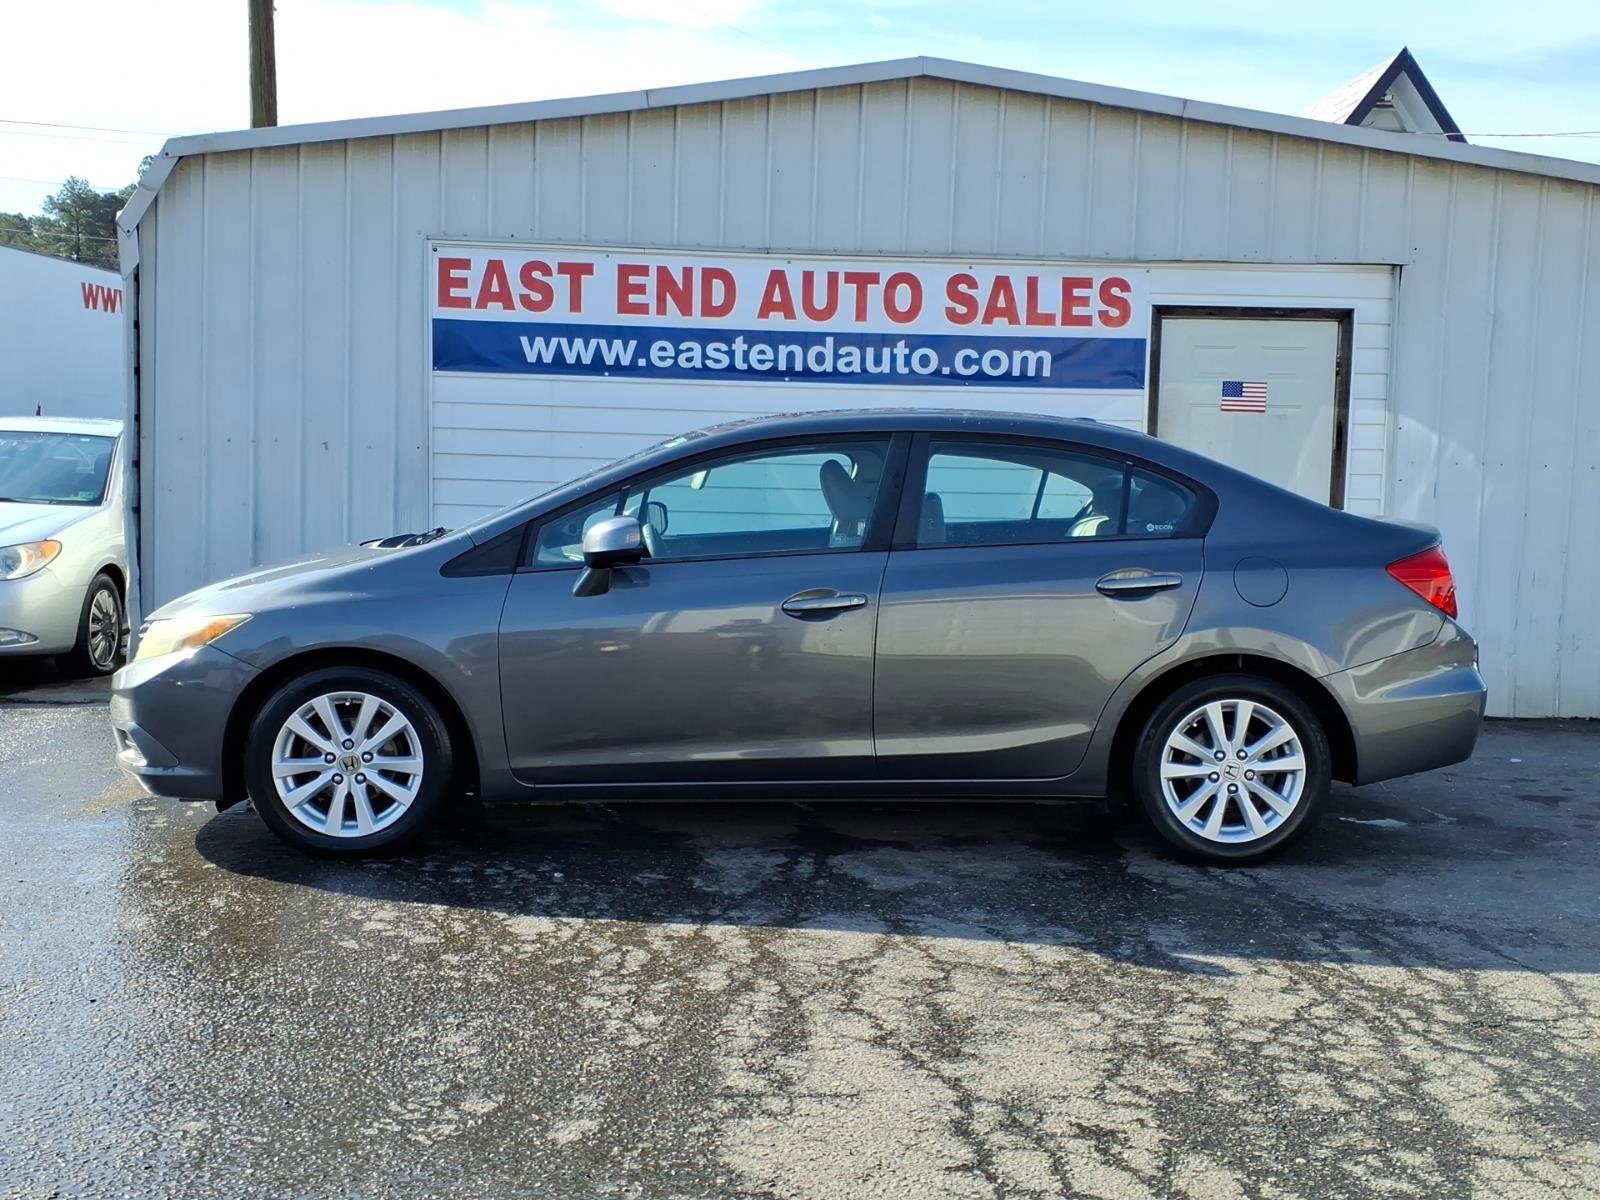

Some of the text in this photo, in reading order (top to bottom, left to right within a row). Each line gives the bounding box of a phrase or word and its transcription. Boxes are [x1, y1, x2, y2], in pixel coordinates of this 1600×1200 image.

[80, 281, 122, 314] WW
[437, 257, 1133, 329] EAST END AUTO SALES
[519, 335, 1053, 378] www.eastendauto.com
